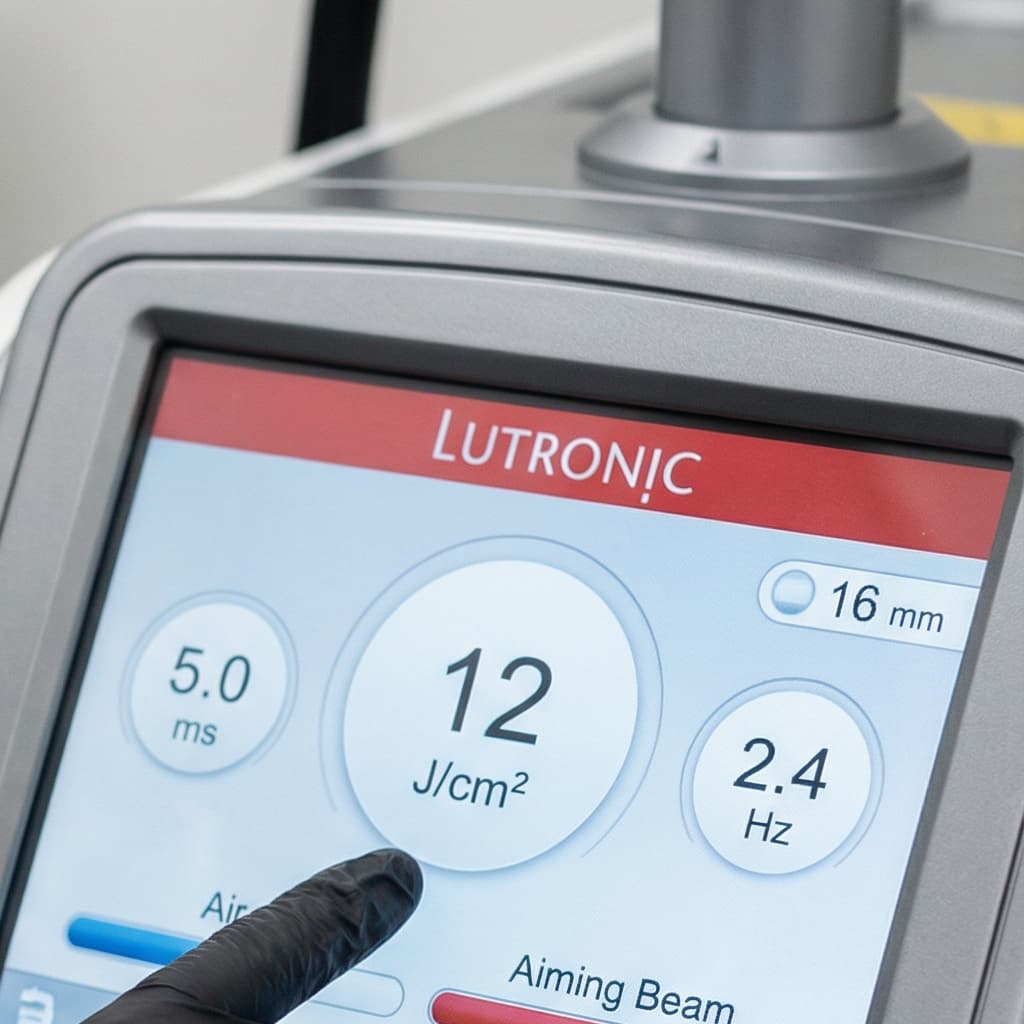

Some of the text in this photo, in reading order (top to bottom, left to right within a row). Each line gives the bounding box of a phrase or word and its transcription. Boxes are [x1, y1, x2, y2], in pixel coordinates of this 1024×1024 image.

[833, 581, 944, 633] 16 mm
[170, 646, 251, 703] 5.0
[446, 647, 552, 745] 12
[172, 719, 217, 746] ms
[412, 759, 529, 809] J/cm²
[733, 737, 828, 800] 2.4
[744, 808, 793, 846] Hz
[200, 891, 247, 923] Air
[509, 954, 625, 1012] Aiming
